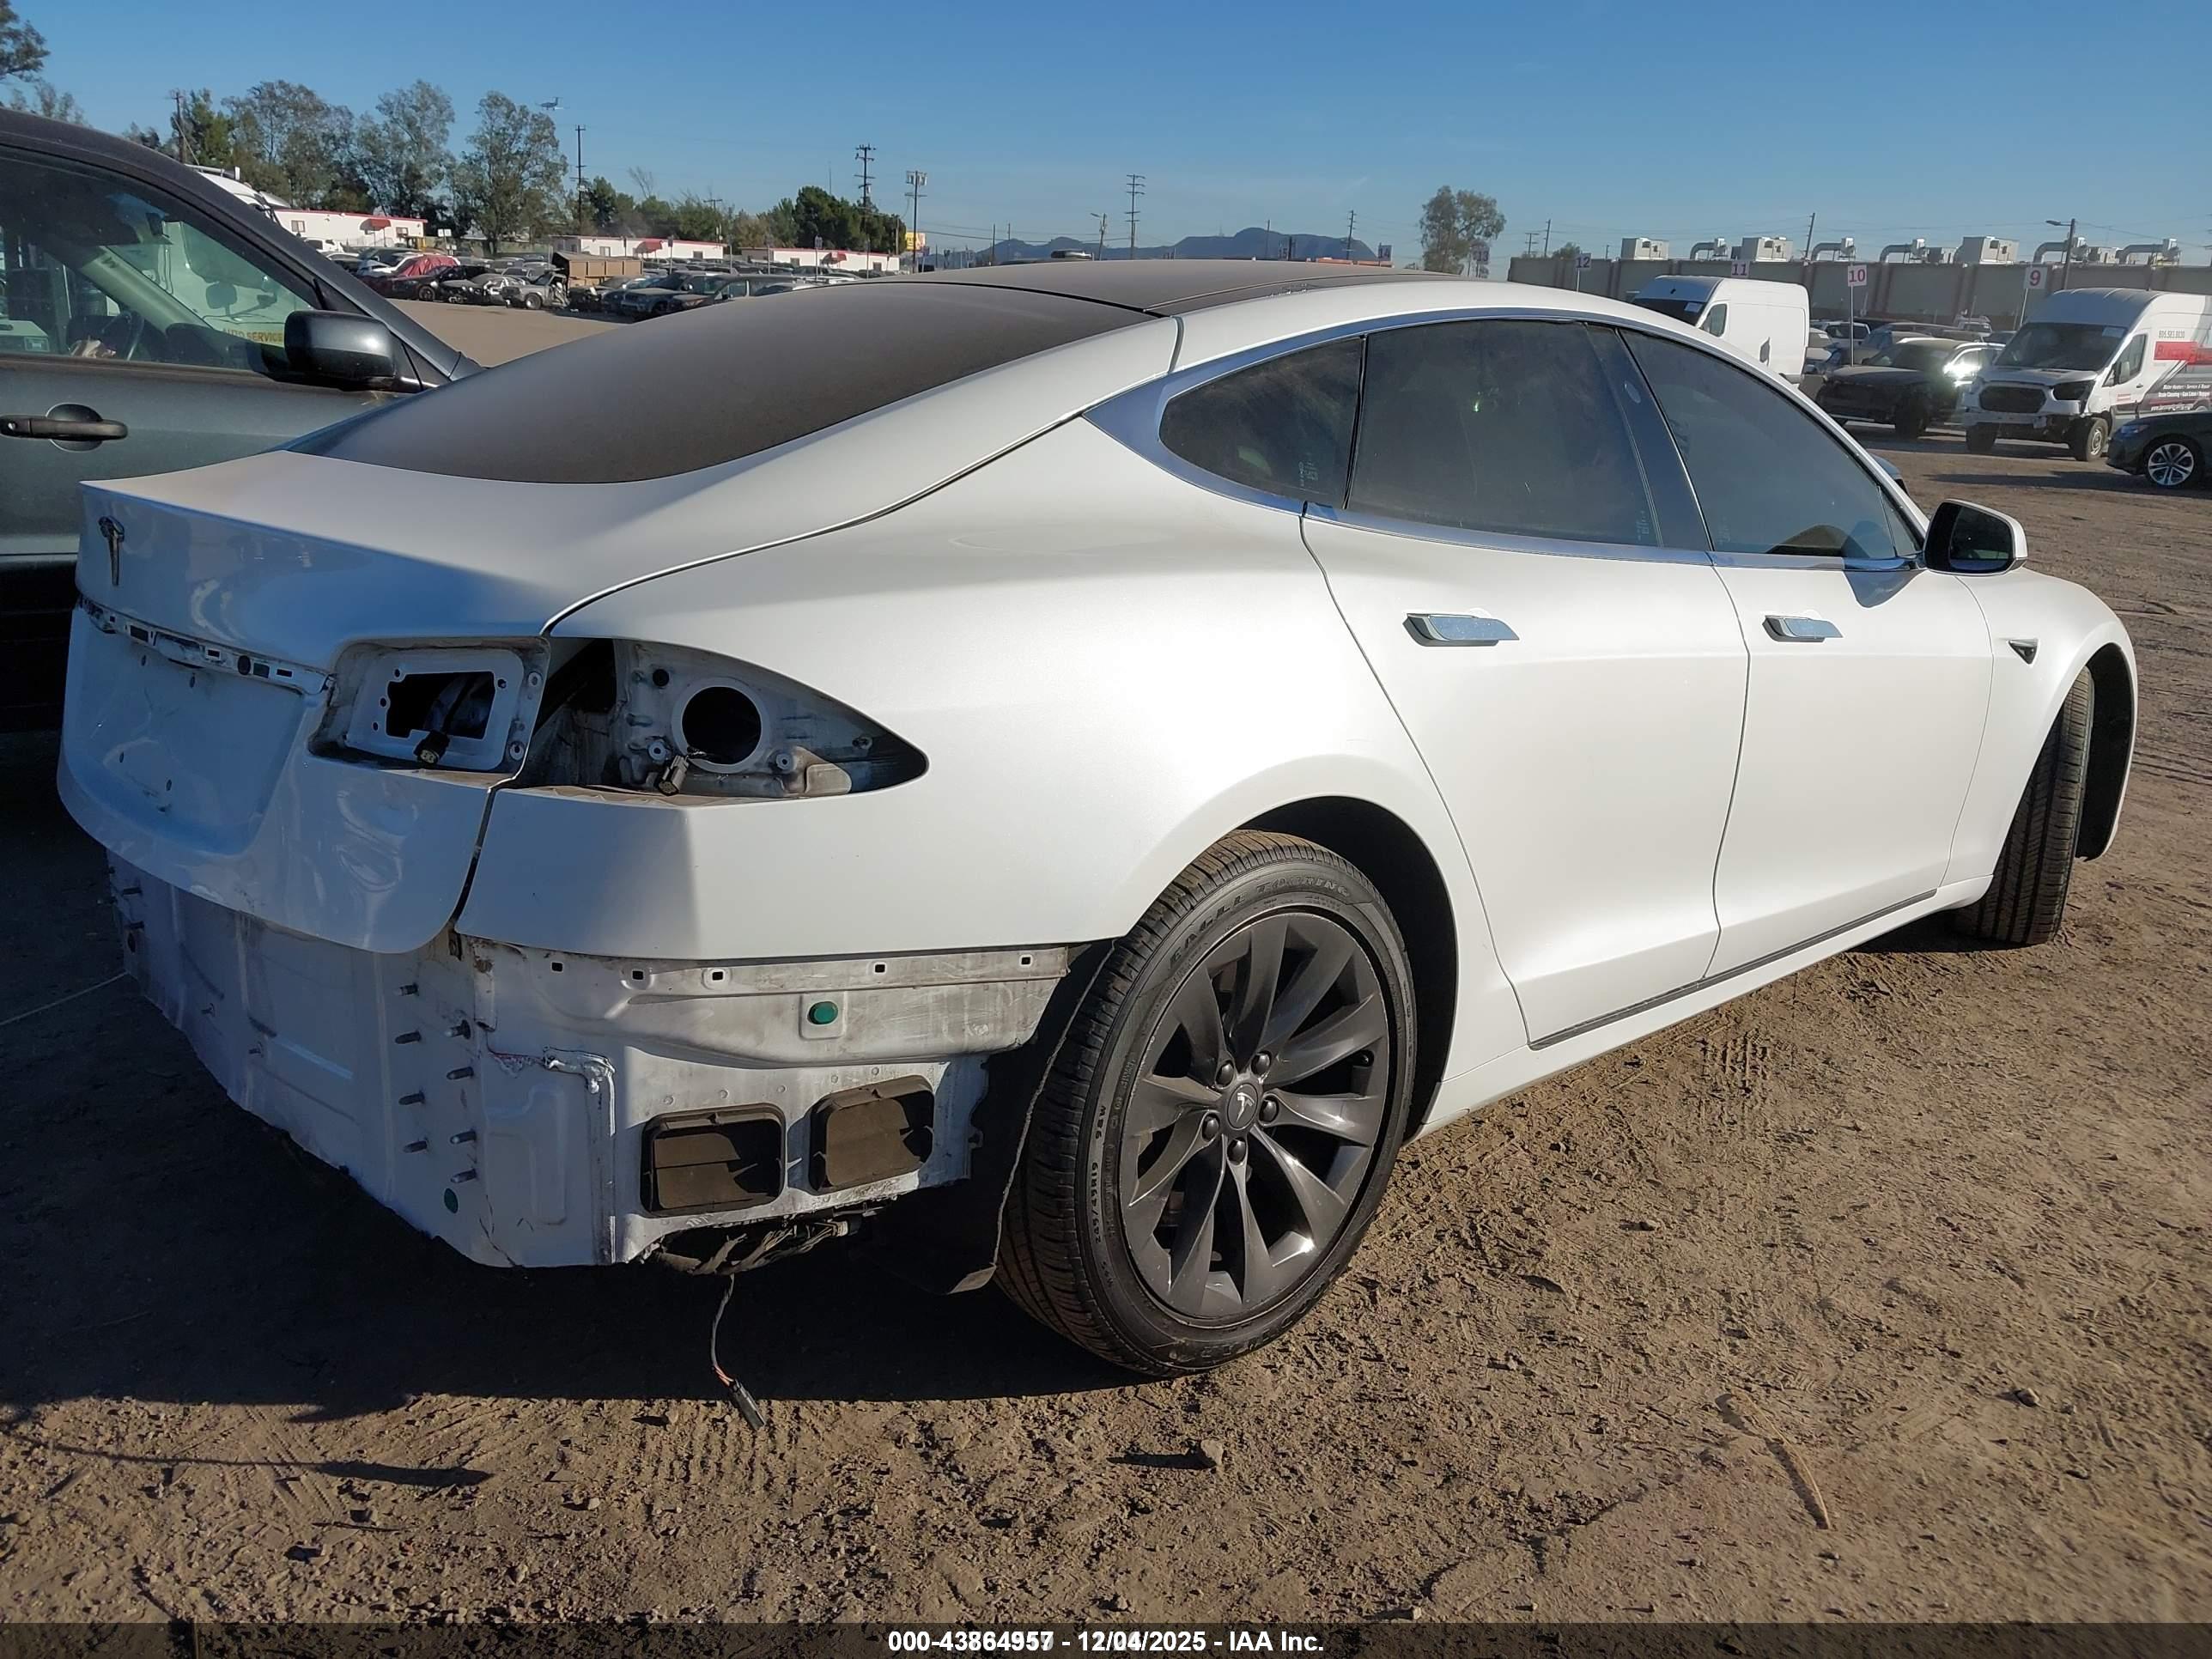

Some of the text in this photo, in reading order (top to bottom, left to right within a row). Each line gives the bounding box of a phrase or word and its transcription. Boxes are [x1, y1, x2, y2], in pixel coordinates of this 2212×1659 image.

[1576, 256, 1590, 269] 12
[1731, 264, 1747, 276] 11
[1849, 269, 1866, 283] 10
[2029, 270, 2041, 286] 9
[246, 331, 283, 343] SERVICE
